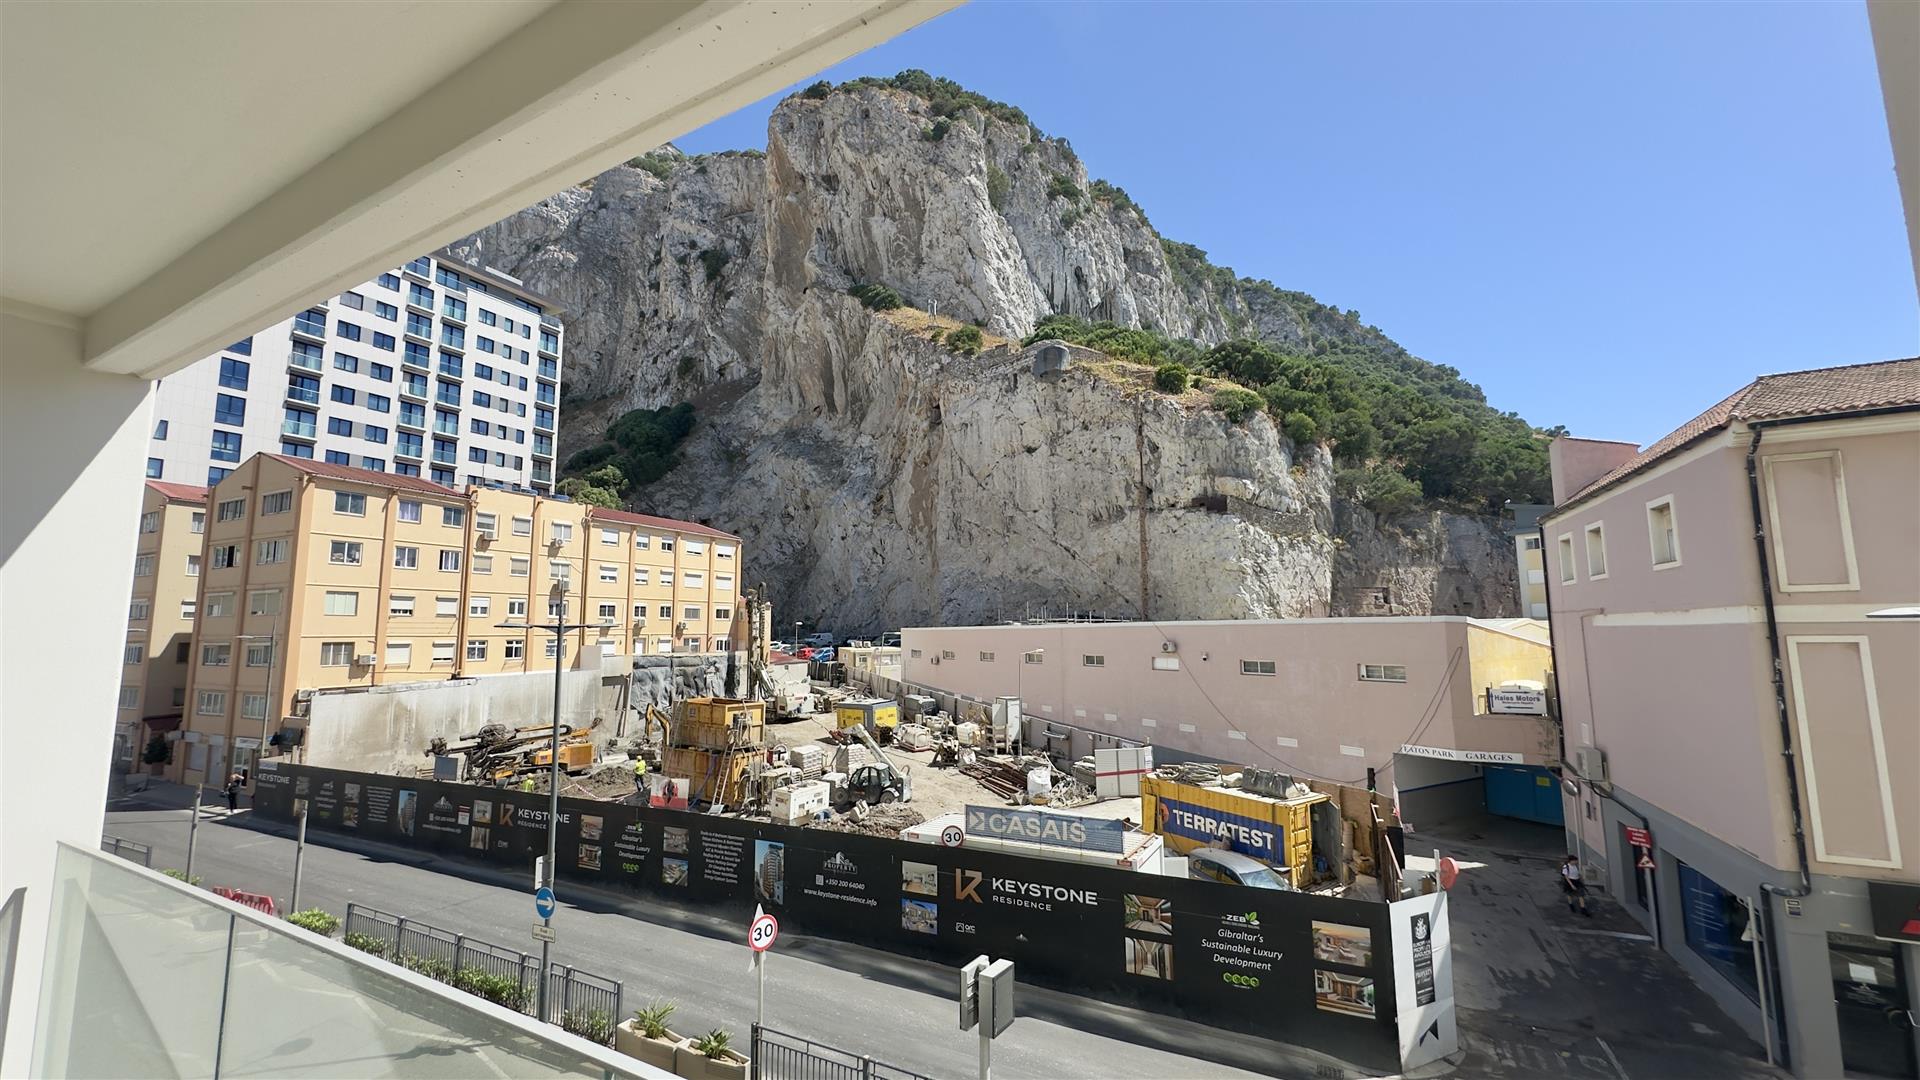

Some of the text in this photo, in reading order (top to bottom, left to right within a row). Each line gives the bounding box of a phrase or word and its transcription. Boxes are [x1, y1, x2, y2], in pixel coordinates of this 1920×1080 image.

[1432, 749, 1455, 759] PARK
[1465, 752, 1513, 761] GARAGES
[258, 773, 291, 785] KEYSTONE
[518, 808, 570, 824] KEYSTNE
[989, 813, 1087, 843] CASAIS
[1172, 809, 1273, 850] TERRATEST
[945, 832, 961, 843] 30
[838, 880, 849, 888] 200
[992, 877, 1099, 906] KEYSTONE
[992, 895, 1052, 912] RESIDENCE
[754, 923, 774, 942] 30
[1217, 928, 1264, 943] Gibraltar's
[1201, 938, 1283, 961] Sustainable Luxury
[1213, 953, 1272, 971] Development
